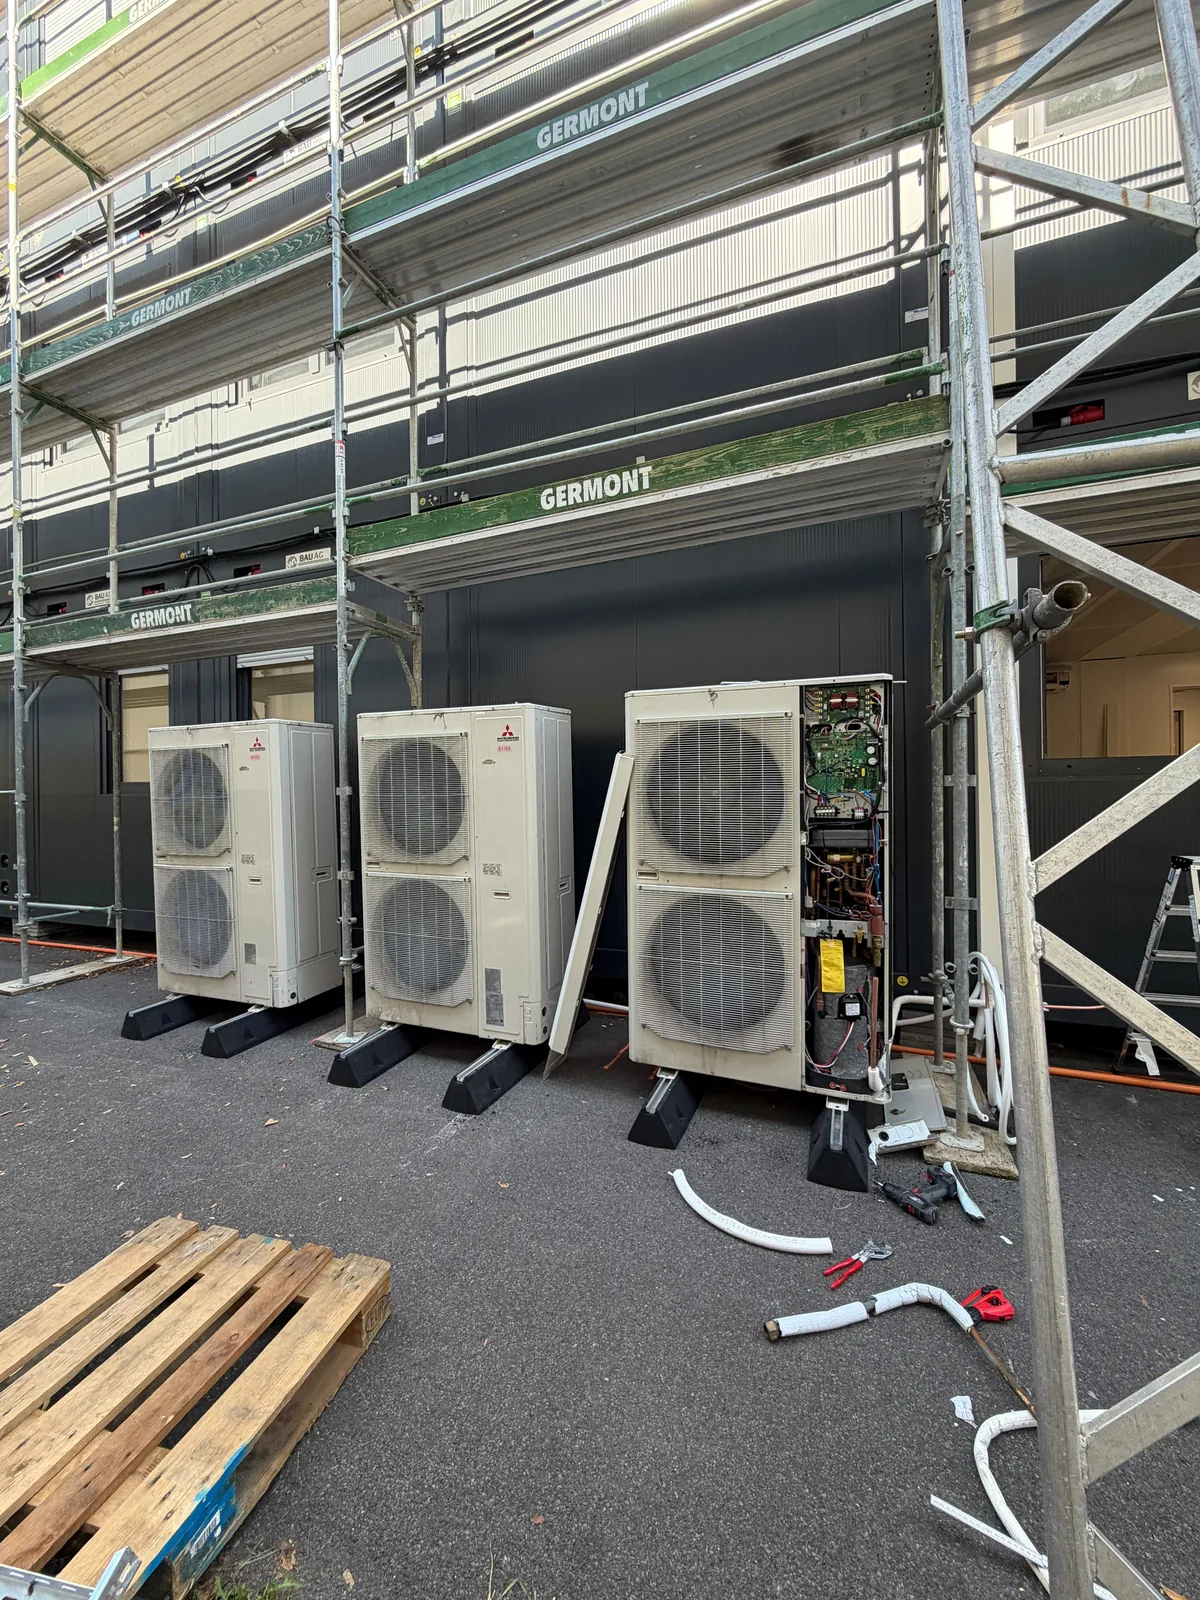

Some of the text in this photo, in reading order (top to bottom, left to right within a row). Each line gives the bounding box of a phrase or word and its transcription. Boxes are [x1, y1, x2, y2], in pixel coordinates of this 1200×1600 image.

[535, 81, 649, 149] GERMONT
[131, 288, 192, 327] GERMONT
[540, 466, 653, 510] GERMONT
[299, 553, 313, 562] BAU
[314, 551, 324, 560] AG
[130, 604, 192, 629] GERMONT
